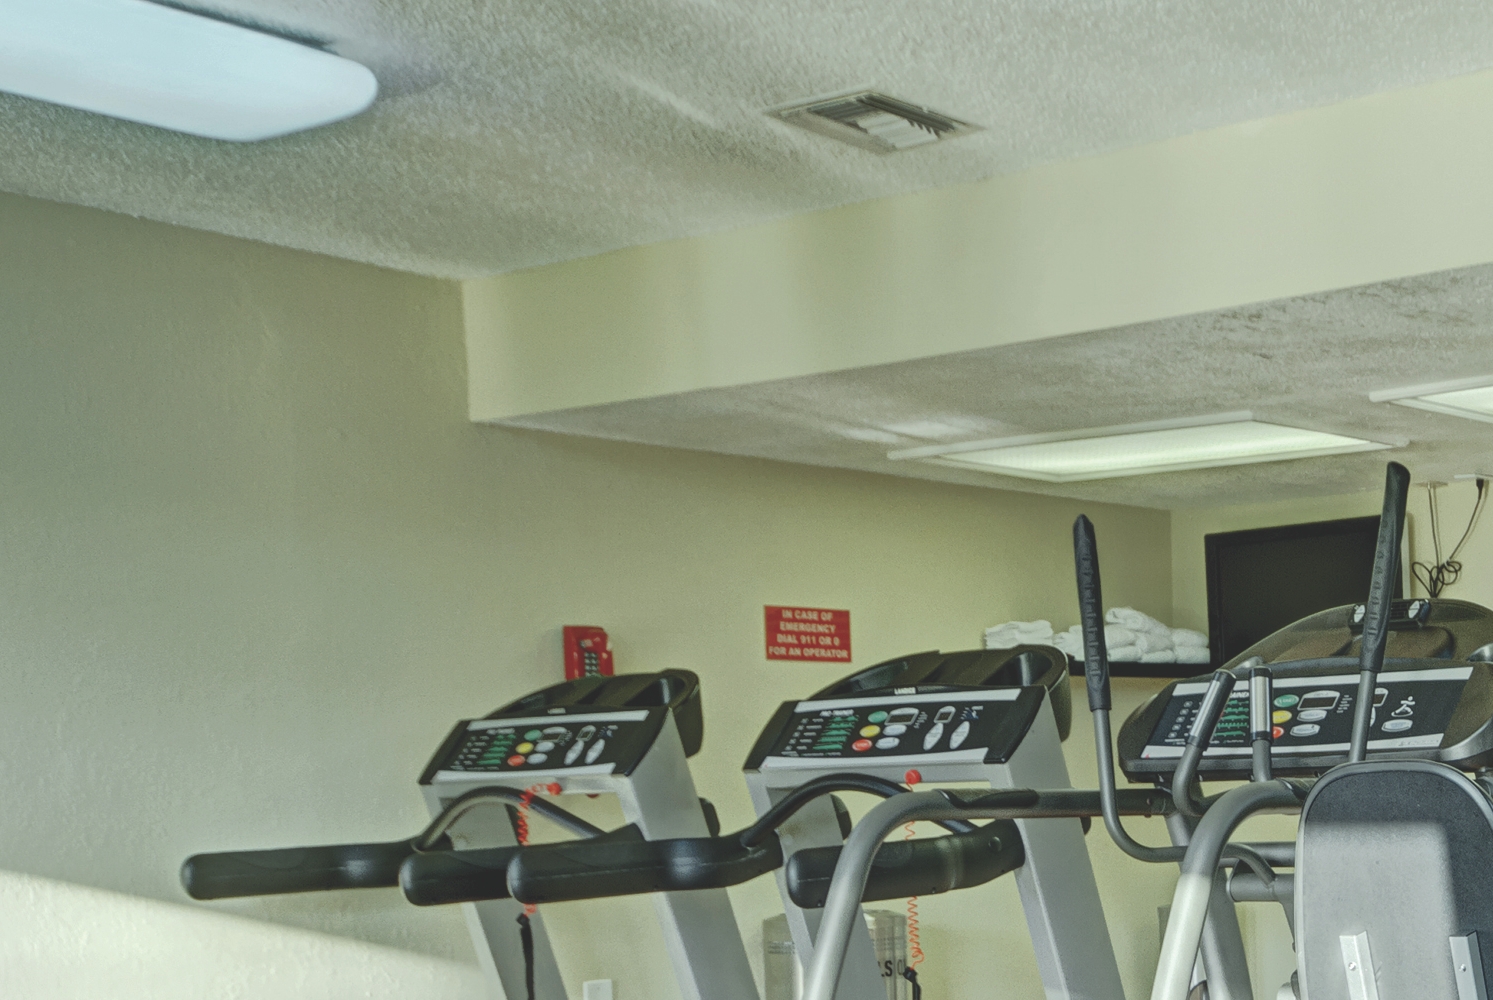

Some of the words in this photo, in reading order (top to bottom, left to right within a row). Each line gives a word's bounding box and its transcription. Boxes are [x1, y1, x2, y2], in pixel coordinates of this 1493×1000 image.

[782, 609, 793, 618] IN
[794, 610, 819, 620] CASE
[820, 611, 833, 621] OF
[780, 621, 836, 633] EMERGENCY
[777, 634, 798, 644] DIAL
[800, 635, 816, 645] 911
[818, 635, 832, 645] OR
[769, 646, 786, 655] FOR
[788, 647, 801, 656] AN
[803, 648, 848, 658] OPERATOR
